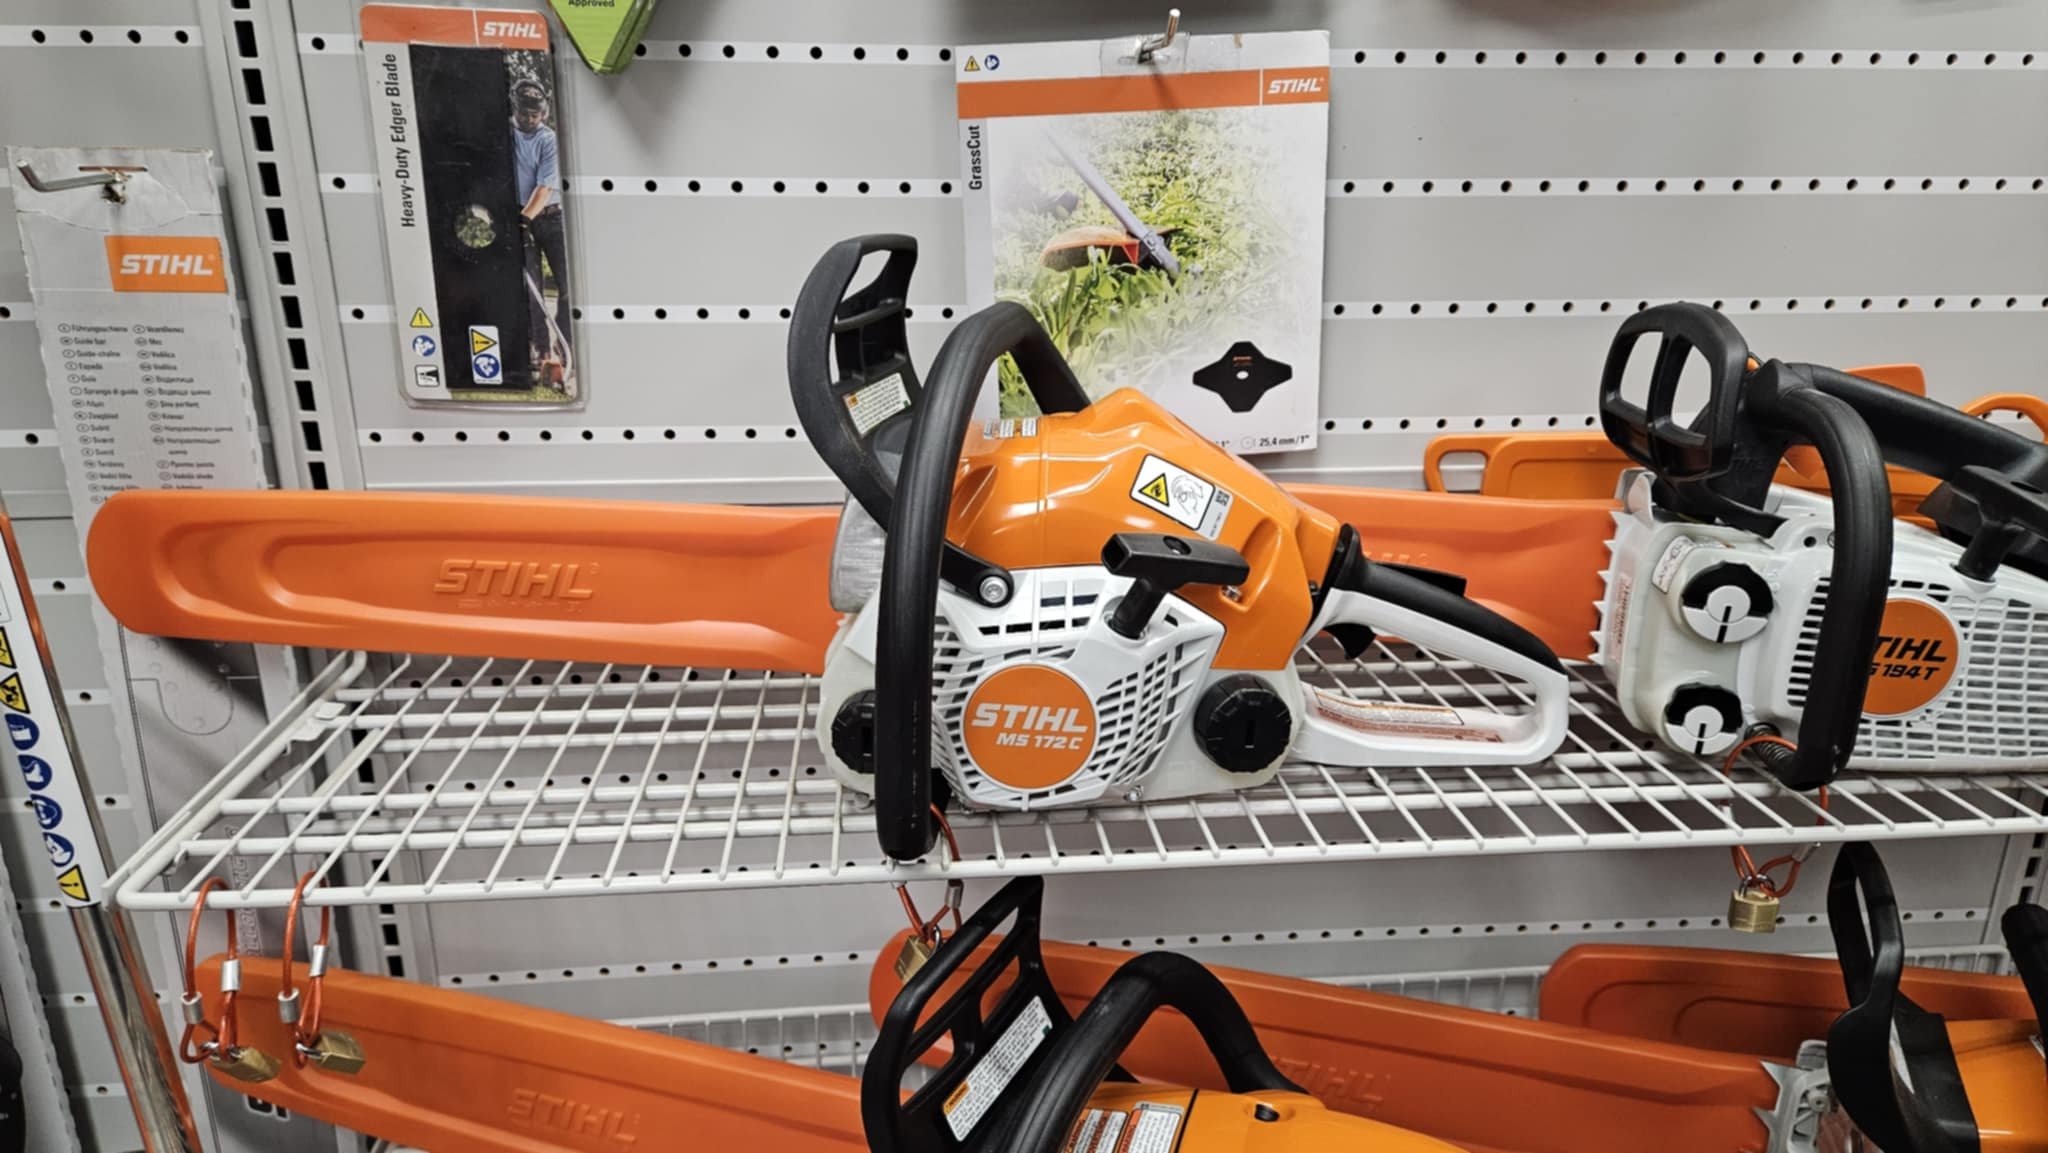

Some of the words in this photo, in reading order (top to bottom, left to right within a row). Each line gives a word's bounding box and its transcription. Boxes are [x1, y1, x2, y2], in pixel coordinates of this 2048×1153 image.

[483, 21, 542, 38] STIHL
[382, 53, 401, 97] Blade
[1267, 77, 1321, 94] STIHL
[390, 101, 407, 144] Edger
[966, 124, 983, 190] GrassCut
[395, 147, 415, 228] Heavy-Duty
[119, 253, 213, 276] STIHL
[433, 559, 593, 600] STIHL
[1873, 635, 1947, 663] TIHL
[971, 702, 1088, 733] STIHL
[996, 732, 1030, 747] MS
[1278, 1057, 1384, 1105] TIHL
[507, 1088, 637, 1143] STIHL
